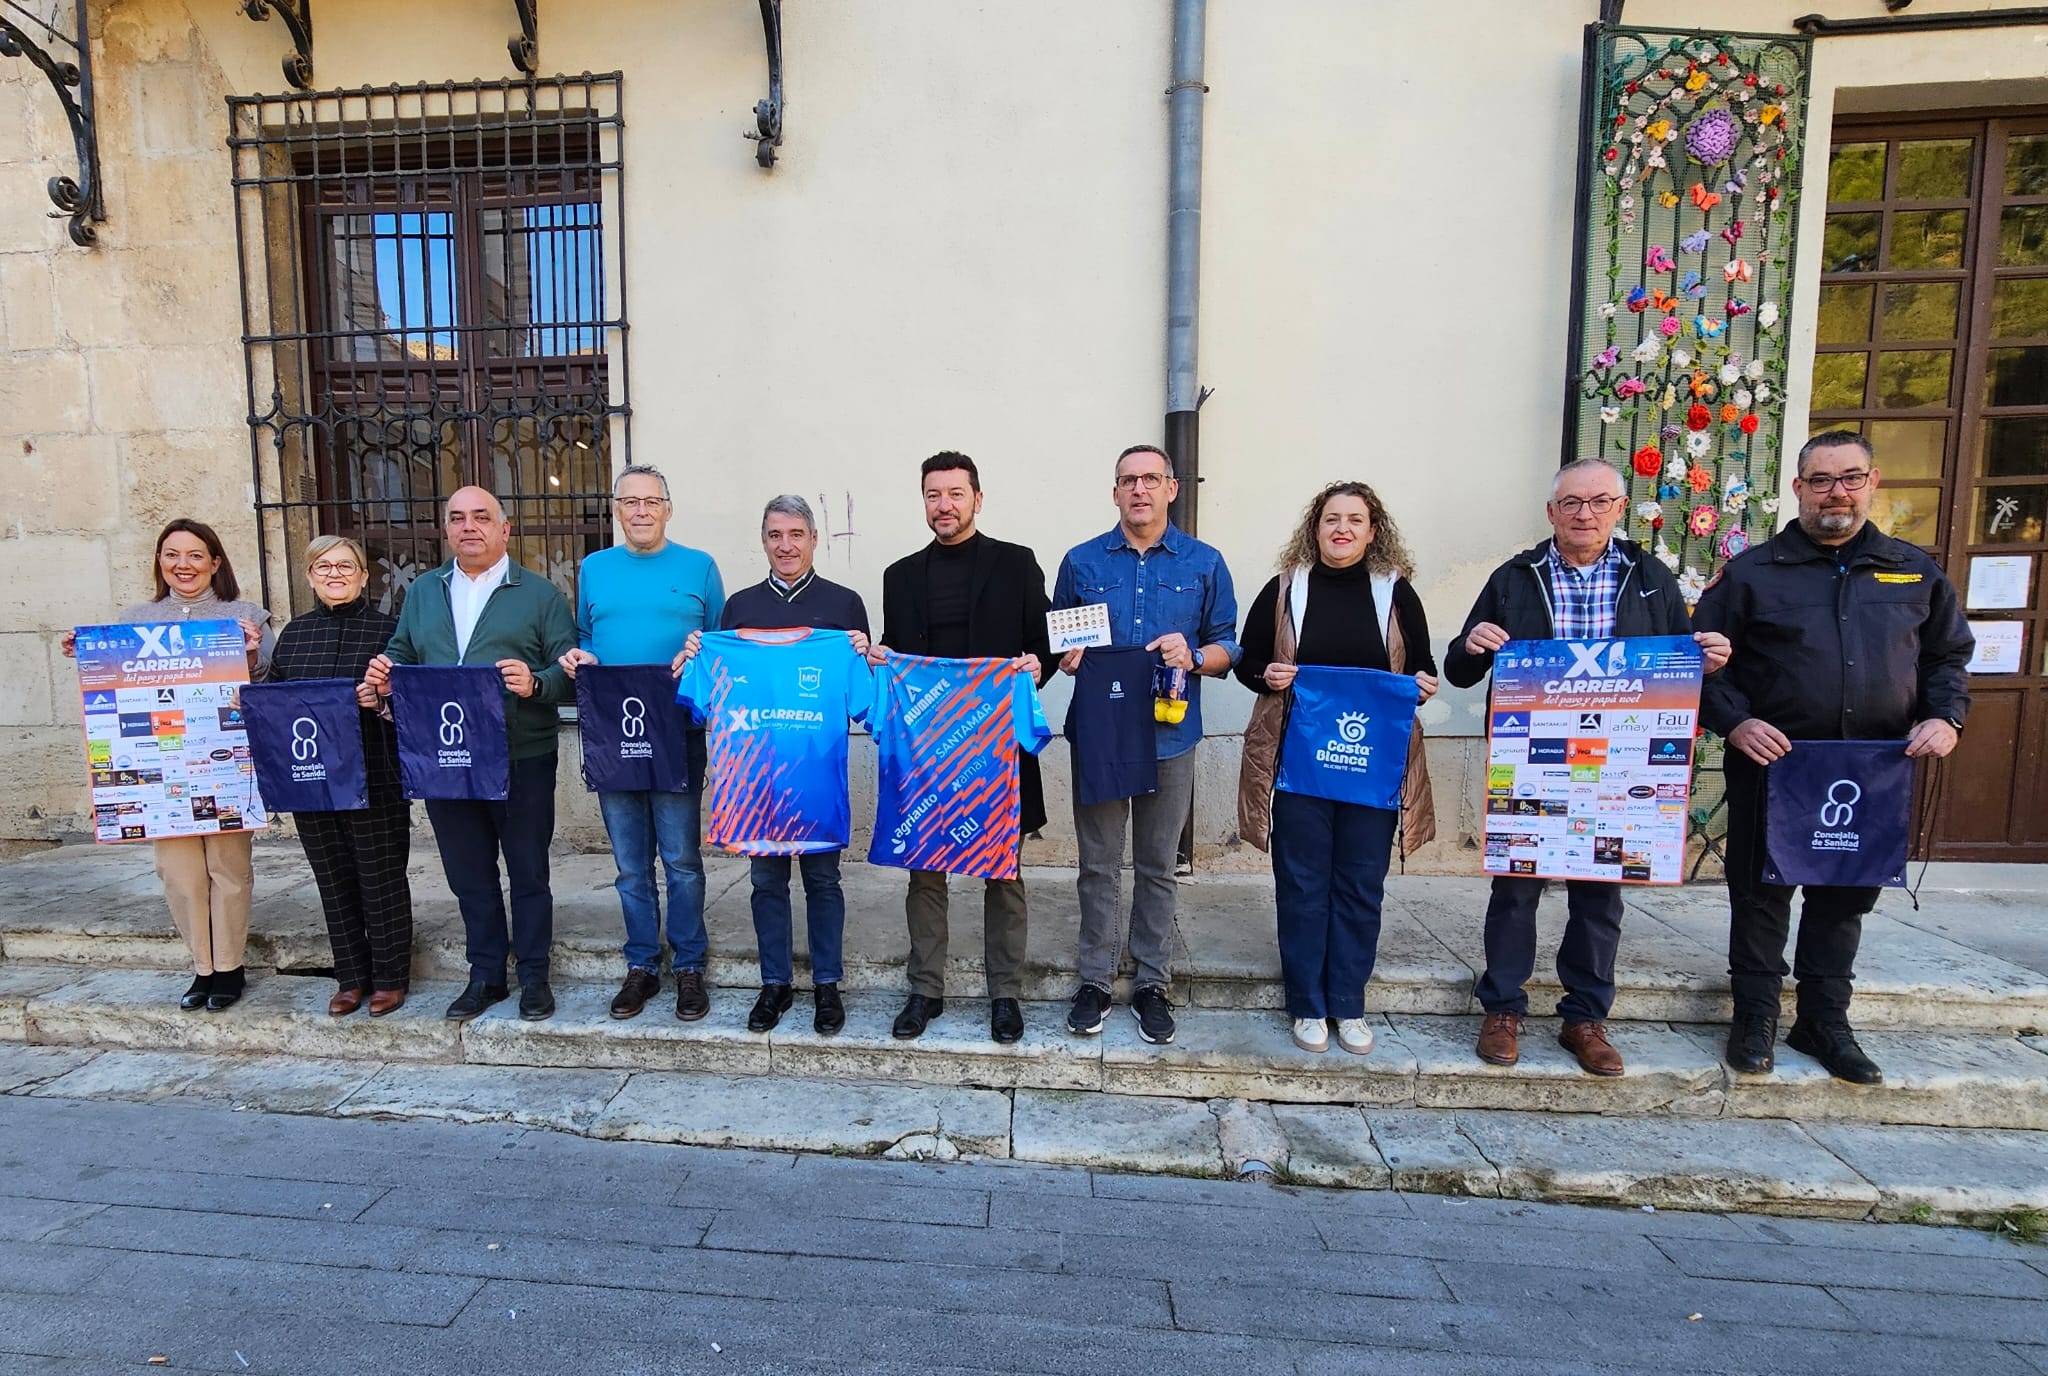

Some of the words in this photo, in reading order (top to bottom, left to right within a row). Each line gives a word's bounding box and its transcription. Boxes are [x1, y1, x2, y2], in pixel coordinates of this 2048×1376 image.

[122, 657, 203, 673] CARRERA
[1640, 655, 1651, 668] 7
[1543, 678, 1644, 694] CARRERA
[1543, 694, 1560, 705] del
[1591, 694, 1618, 707] papá
[1618, 693, 1642, 703] noel
[761, 708, 824, 722] CARRERA
[1657, 712, 1689, 726] Fau
[935, 702, 994, 759] SANTAMAR
[1612, 724, 1649, 733] amay
[1327, 739, 1370, 756] Costa
[1316, 749, 1368, 767] Blanca
[894, 793, 938, 837] agriauto
[950, 817, 980, 845] Fau
[1811, 838, 1823, 846] de
[1824, 839, 1859, 847] Sanidad
